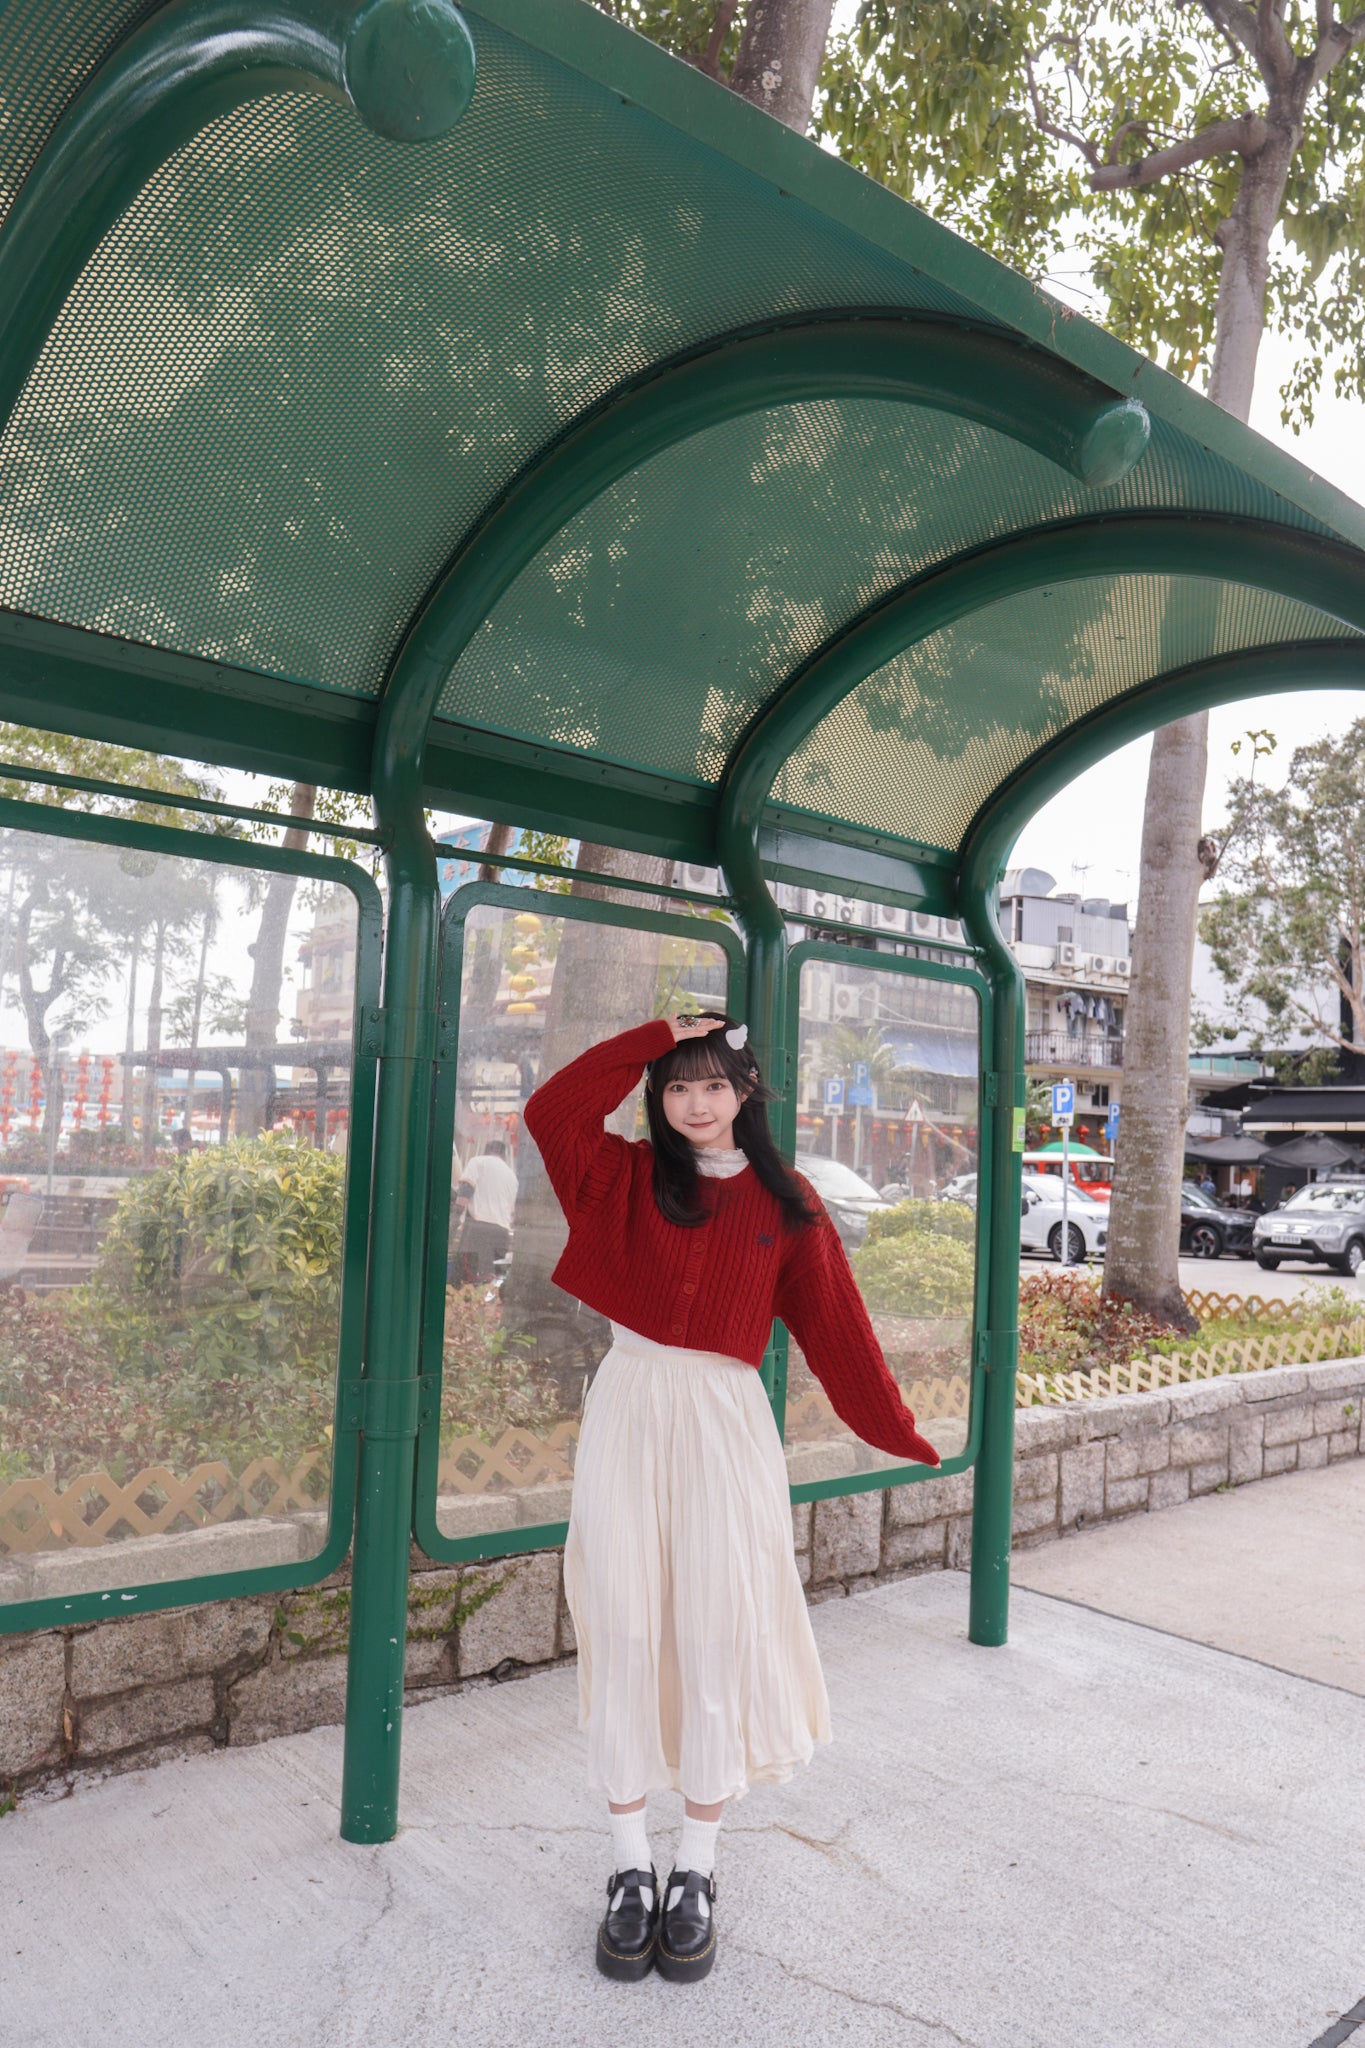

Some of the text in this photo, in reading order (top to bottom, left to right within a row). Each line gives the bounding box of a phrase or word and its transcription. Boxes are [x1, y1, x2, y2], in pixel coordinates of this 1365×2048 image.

[857, 1063, 867, 1084] P
[827, 1082, 841, 1103] P
[1056, 1087, 1071, 1111] P
[1111, 1104, 1120, 1123] P
